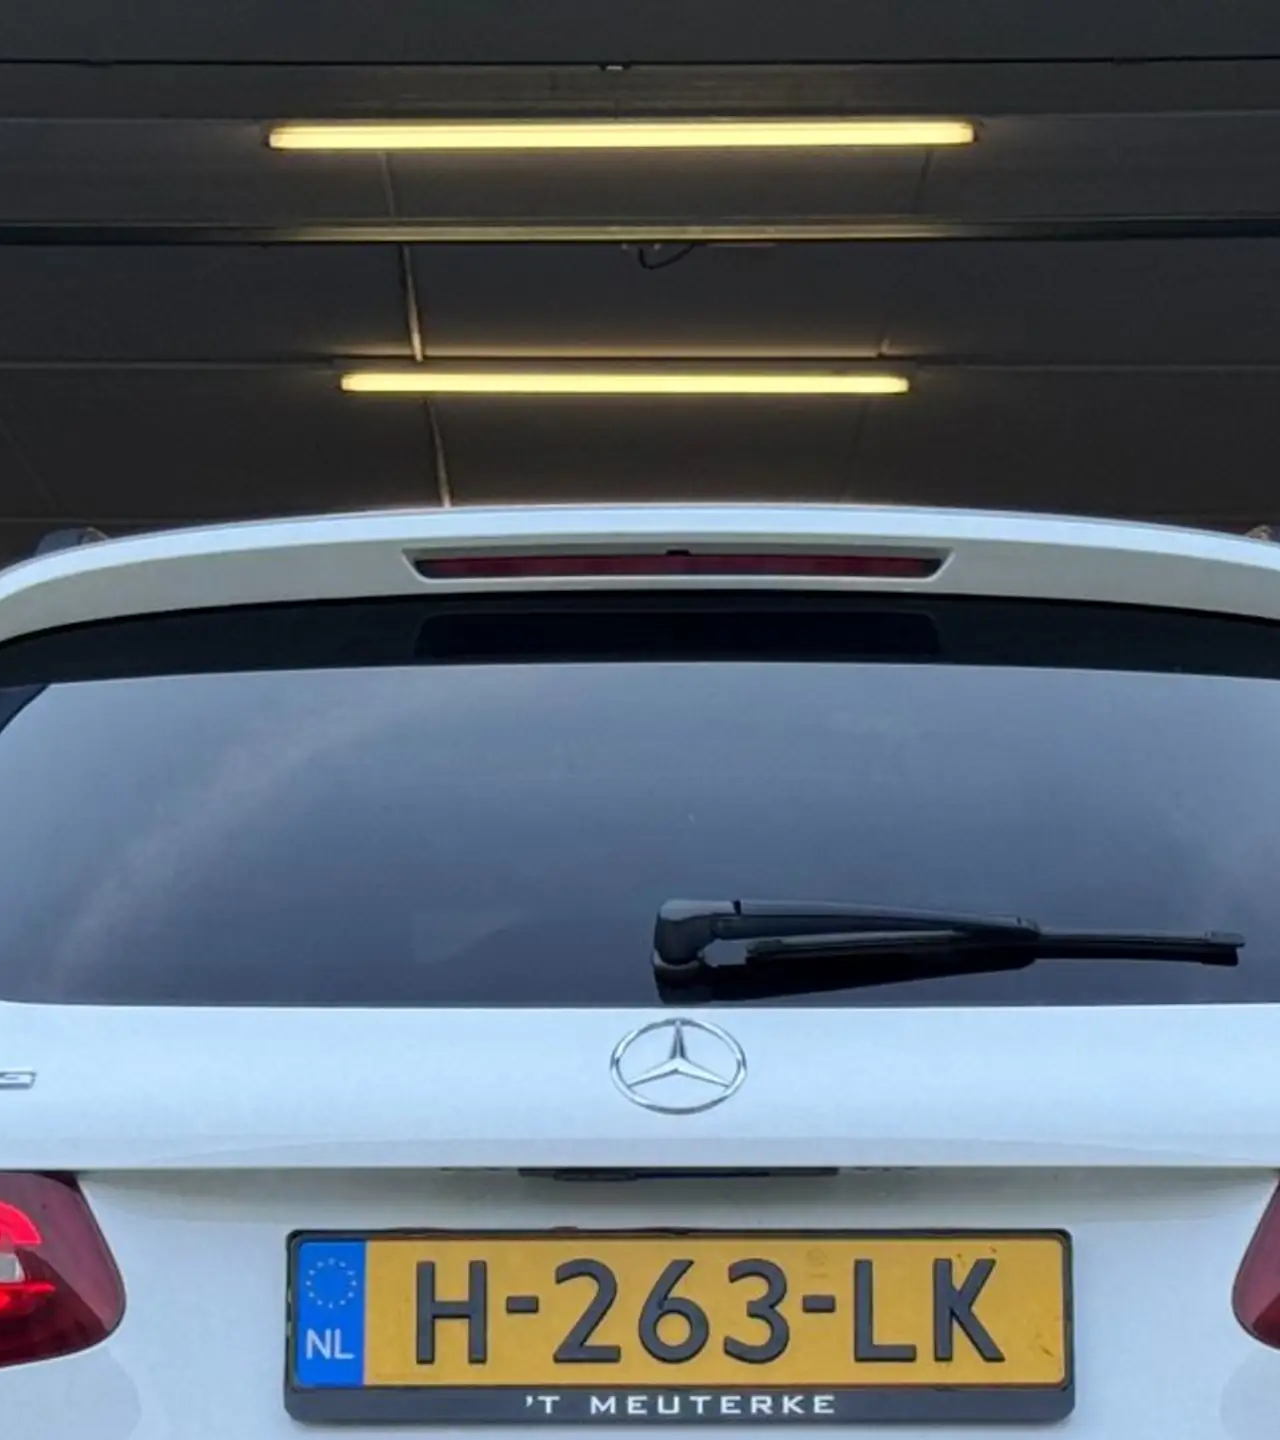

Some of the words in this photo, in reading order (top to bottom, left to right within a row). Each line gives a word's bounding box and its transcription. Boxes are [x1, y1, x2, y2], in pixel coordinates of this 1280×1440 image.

[306, 1330, 355, 1360] NL
[415, 1258, 1006, 1363] H-263-LK
[525, 1396, 559, 1415] 'T
[589, 1395, 837, 1415] MEUTERKE
